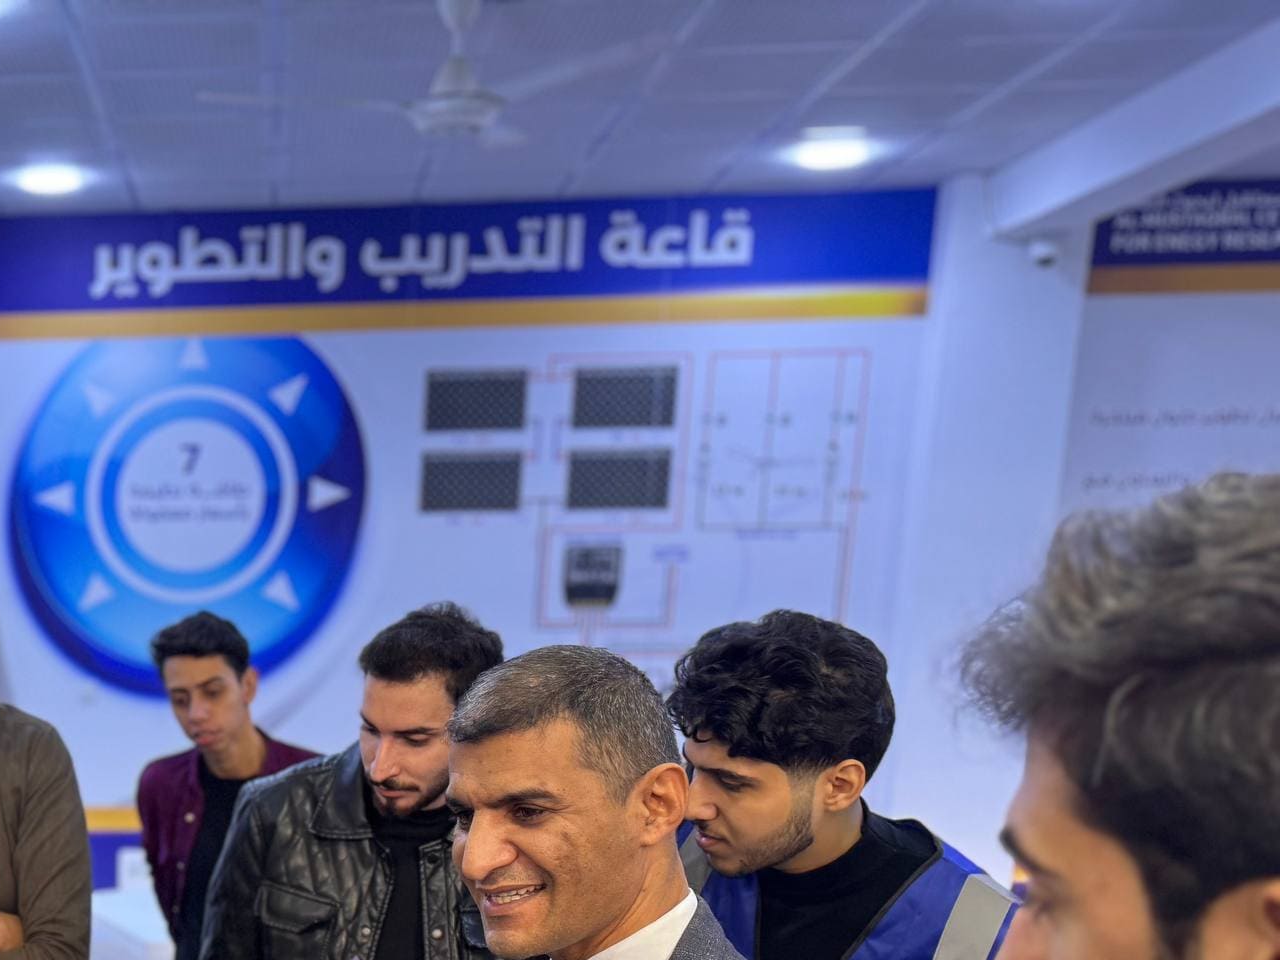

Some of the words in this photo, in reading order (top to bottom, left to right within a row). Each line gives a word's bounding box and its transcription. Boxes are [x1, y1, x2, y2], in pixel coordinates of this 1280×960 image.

[90, 223, 347, 299] والتطوير
[359, 213, 586, 292] التدريب
[600, 210, 753, 267] قاعة
[180, 442, 201, 475] 7
